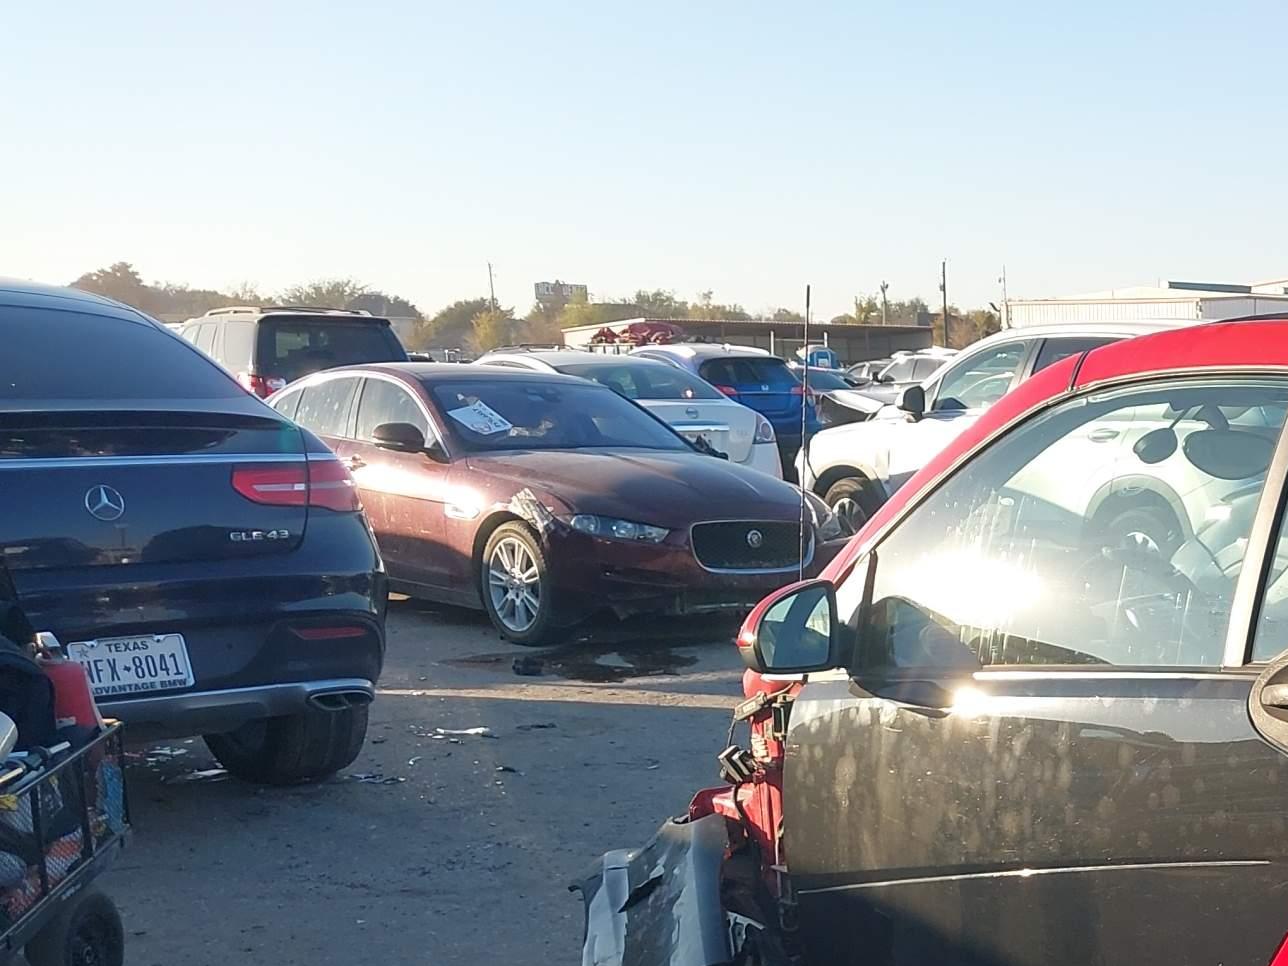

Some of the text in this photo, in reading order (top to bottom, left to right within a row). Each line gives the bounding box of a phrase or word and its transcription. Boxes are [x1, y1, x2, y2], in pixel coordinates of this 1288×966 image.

[230, 525, 289, 541] GLE 43
[105, 640, 149, 653] TEXAS
[132, 653, 183, 679] 8041
[160, 678, 187, 689] BMW
